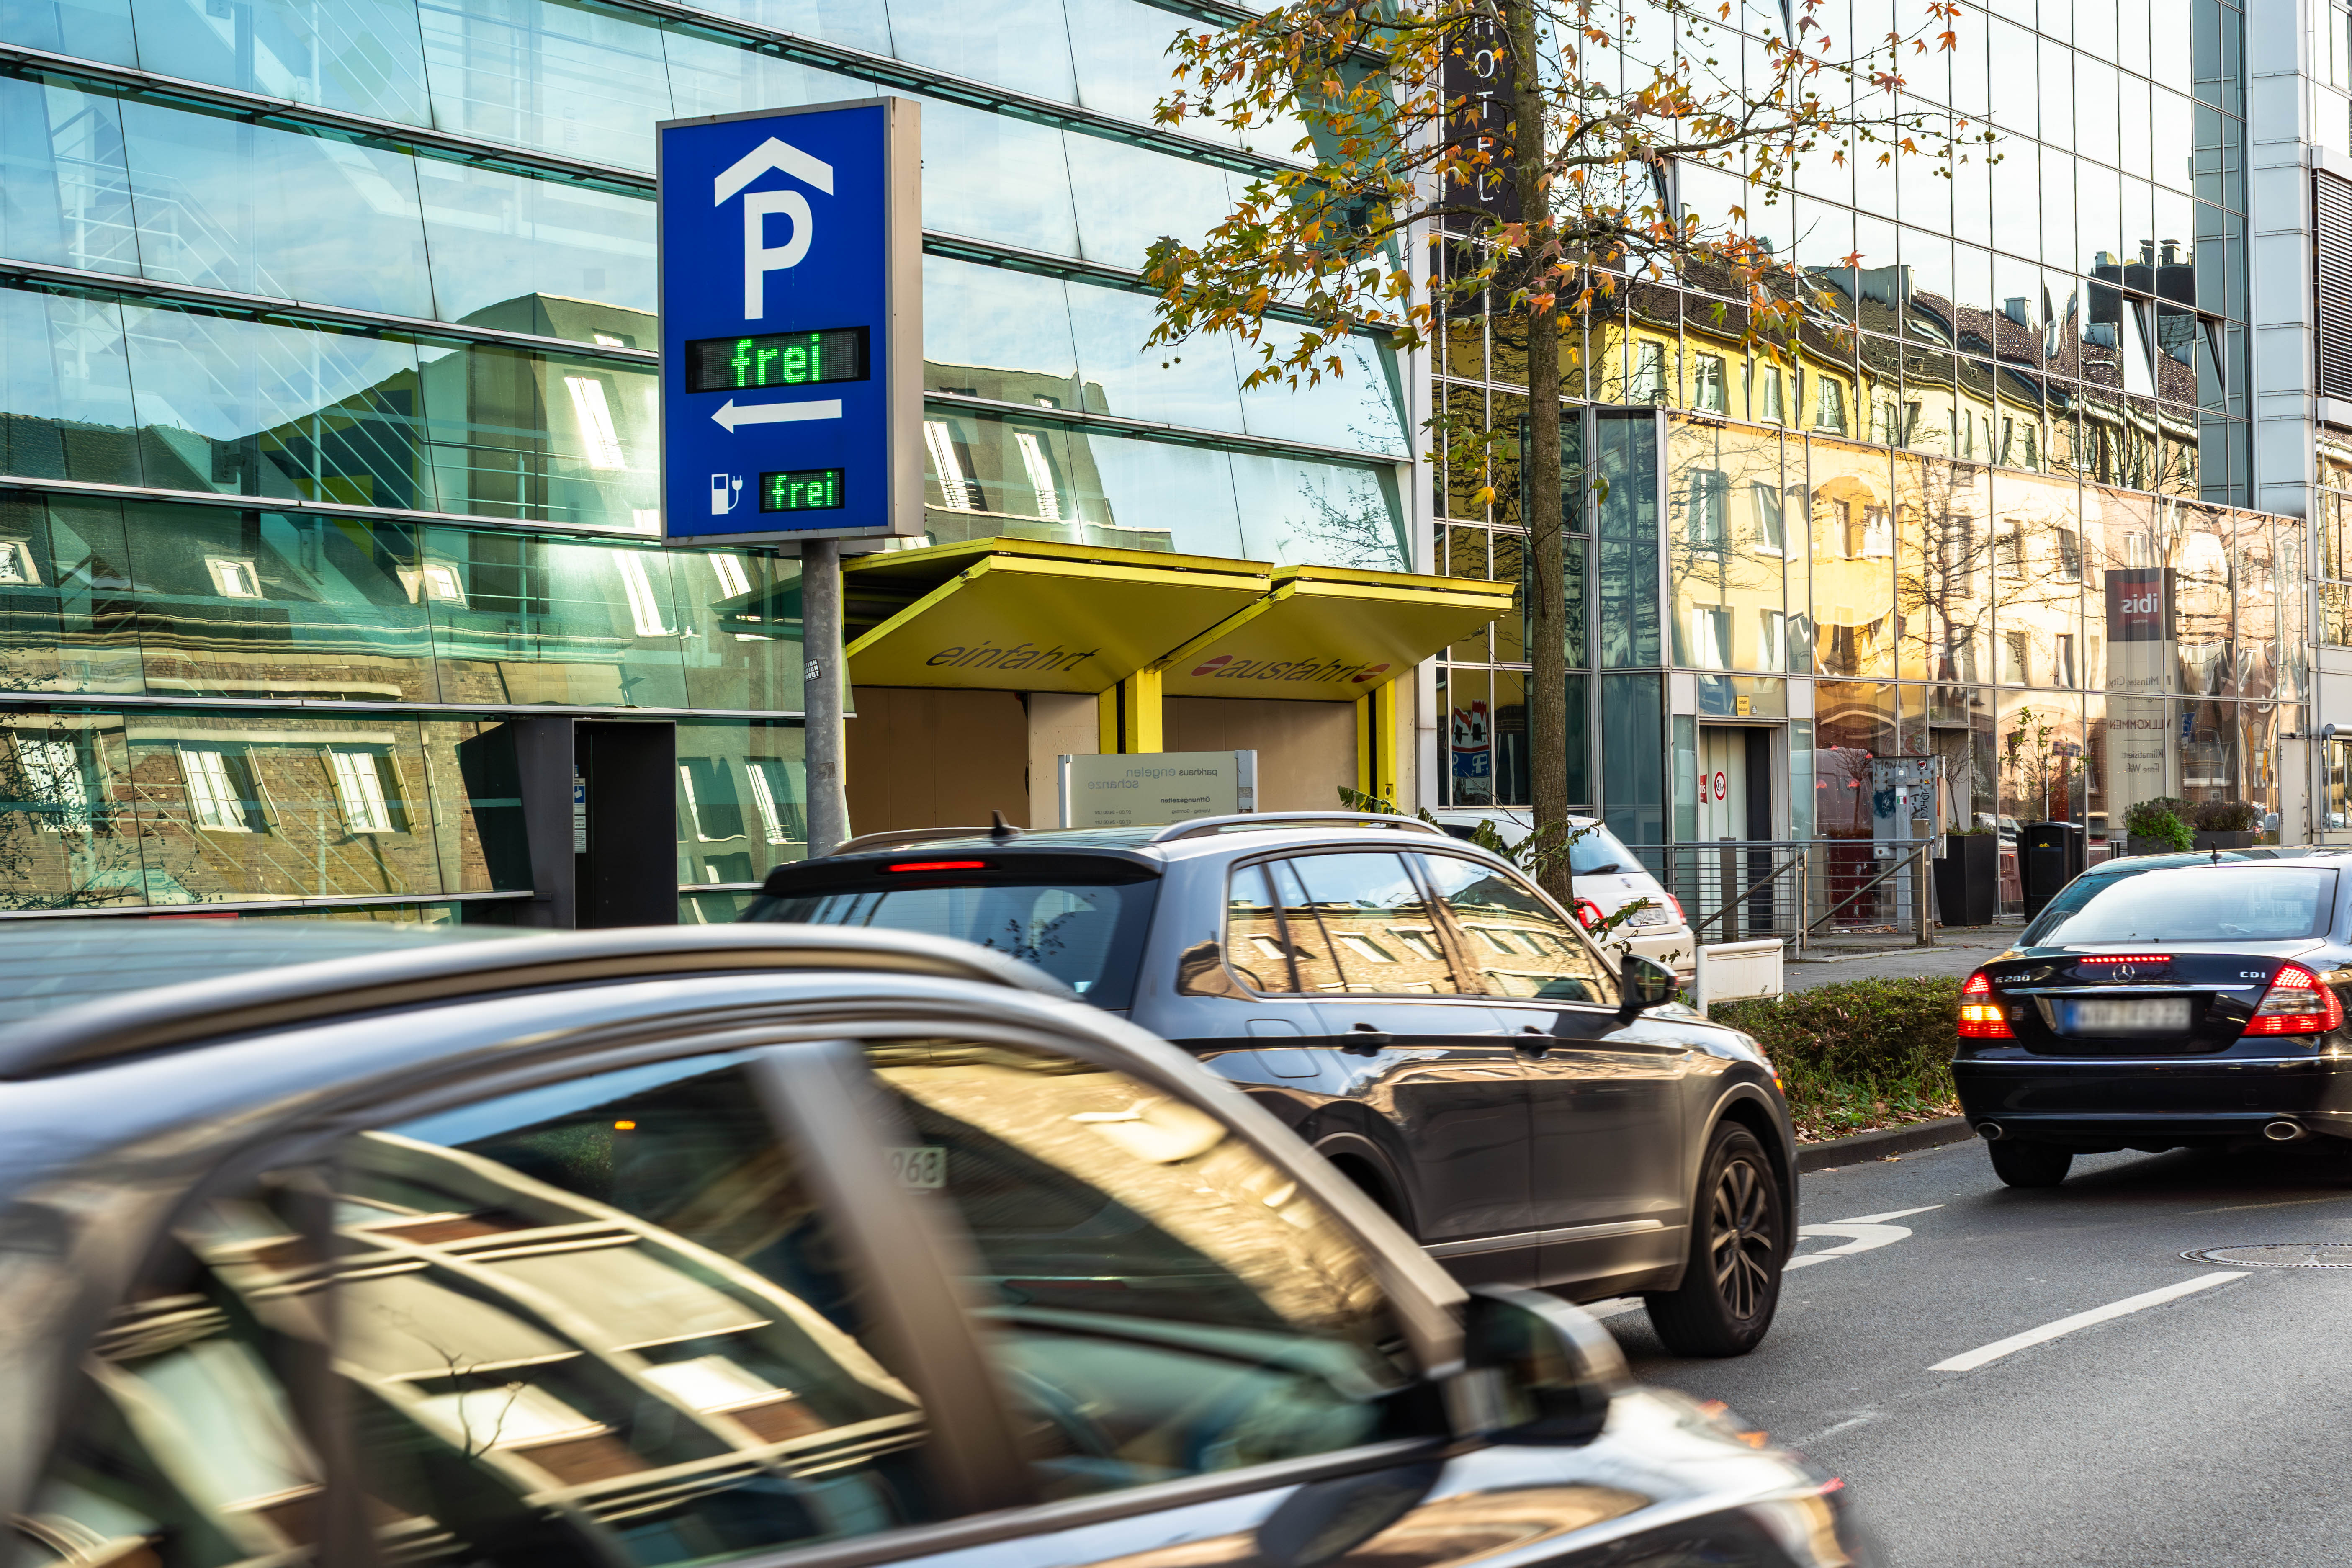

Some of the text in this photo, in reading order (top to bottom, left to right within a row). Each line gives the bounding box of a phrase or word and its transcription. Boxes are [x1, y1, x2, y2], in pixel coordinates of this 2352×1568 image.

[744, 190, 813, 320] P
[731, 334, 820, 387] frei
[772, 472, 833, 509] frei
[926, 641, 1102, 672] einfahrt
[1214, 657, 1371, 683] ausfahrt
